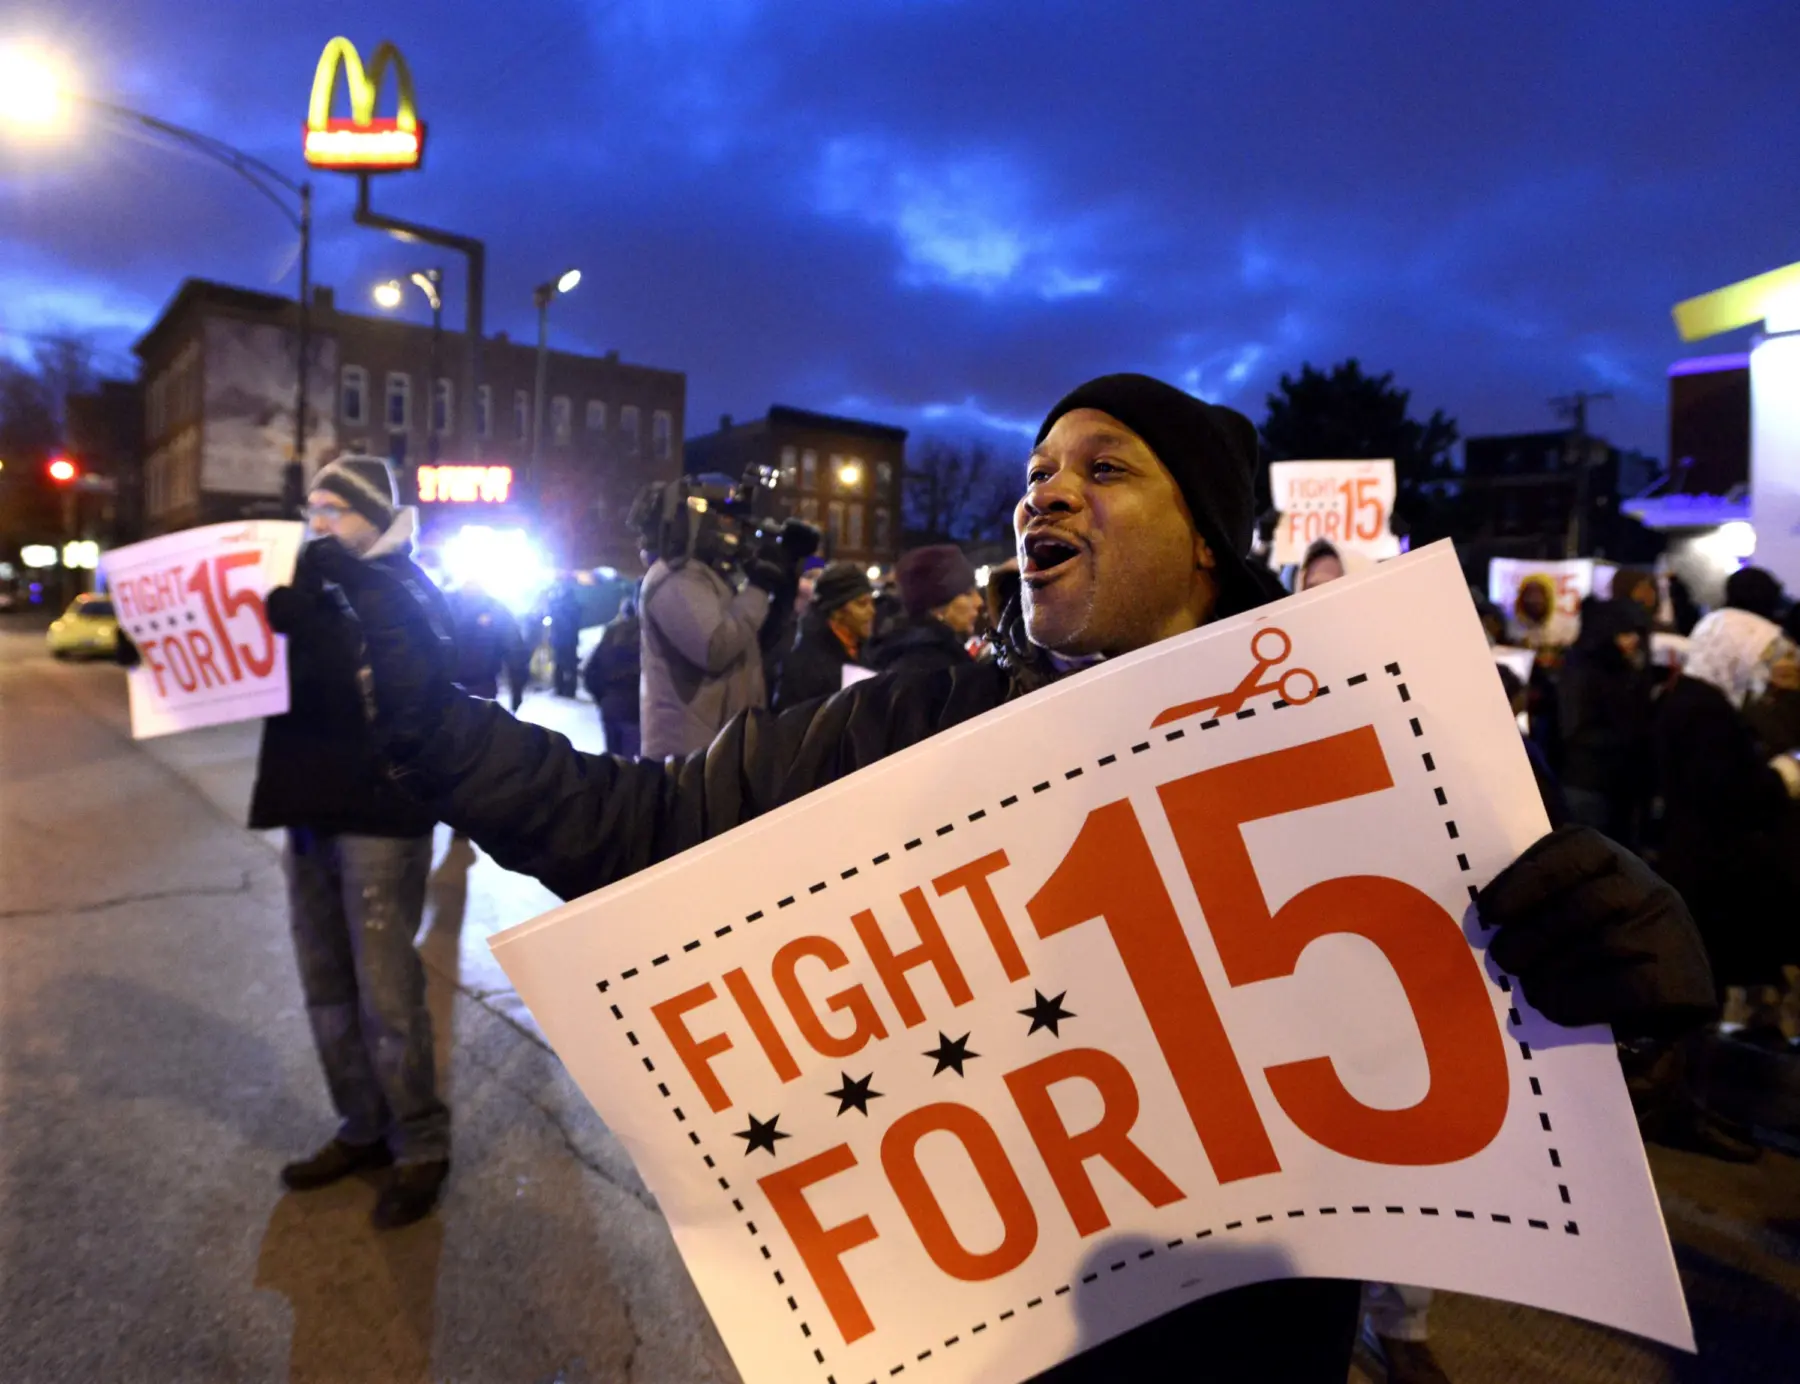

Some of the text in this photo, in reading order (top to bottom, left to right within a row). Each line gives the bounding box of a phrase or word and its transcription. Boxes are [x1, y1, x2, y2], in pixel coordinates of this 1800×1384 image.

[1288, 512, 1340, 544] FOR
[1339, 478, 1385, 541] 15
[117, 566, 187, 619] FIGHT
[187, 550, 274, 681] 15
[140, 629, 227, 697] FOR
[651, 849, 1030, 1112] FIGHT
[1026, 725, 1509, 1184] 15
[757, 1048, 1185, 1344] FOR
